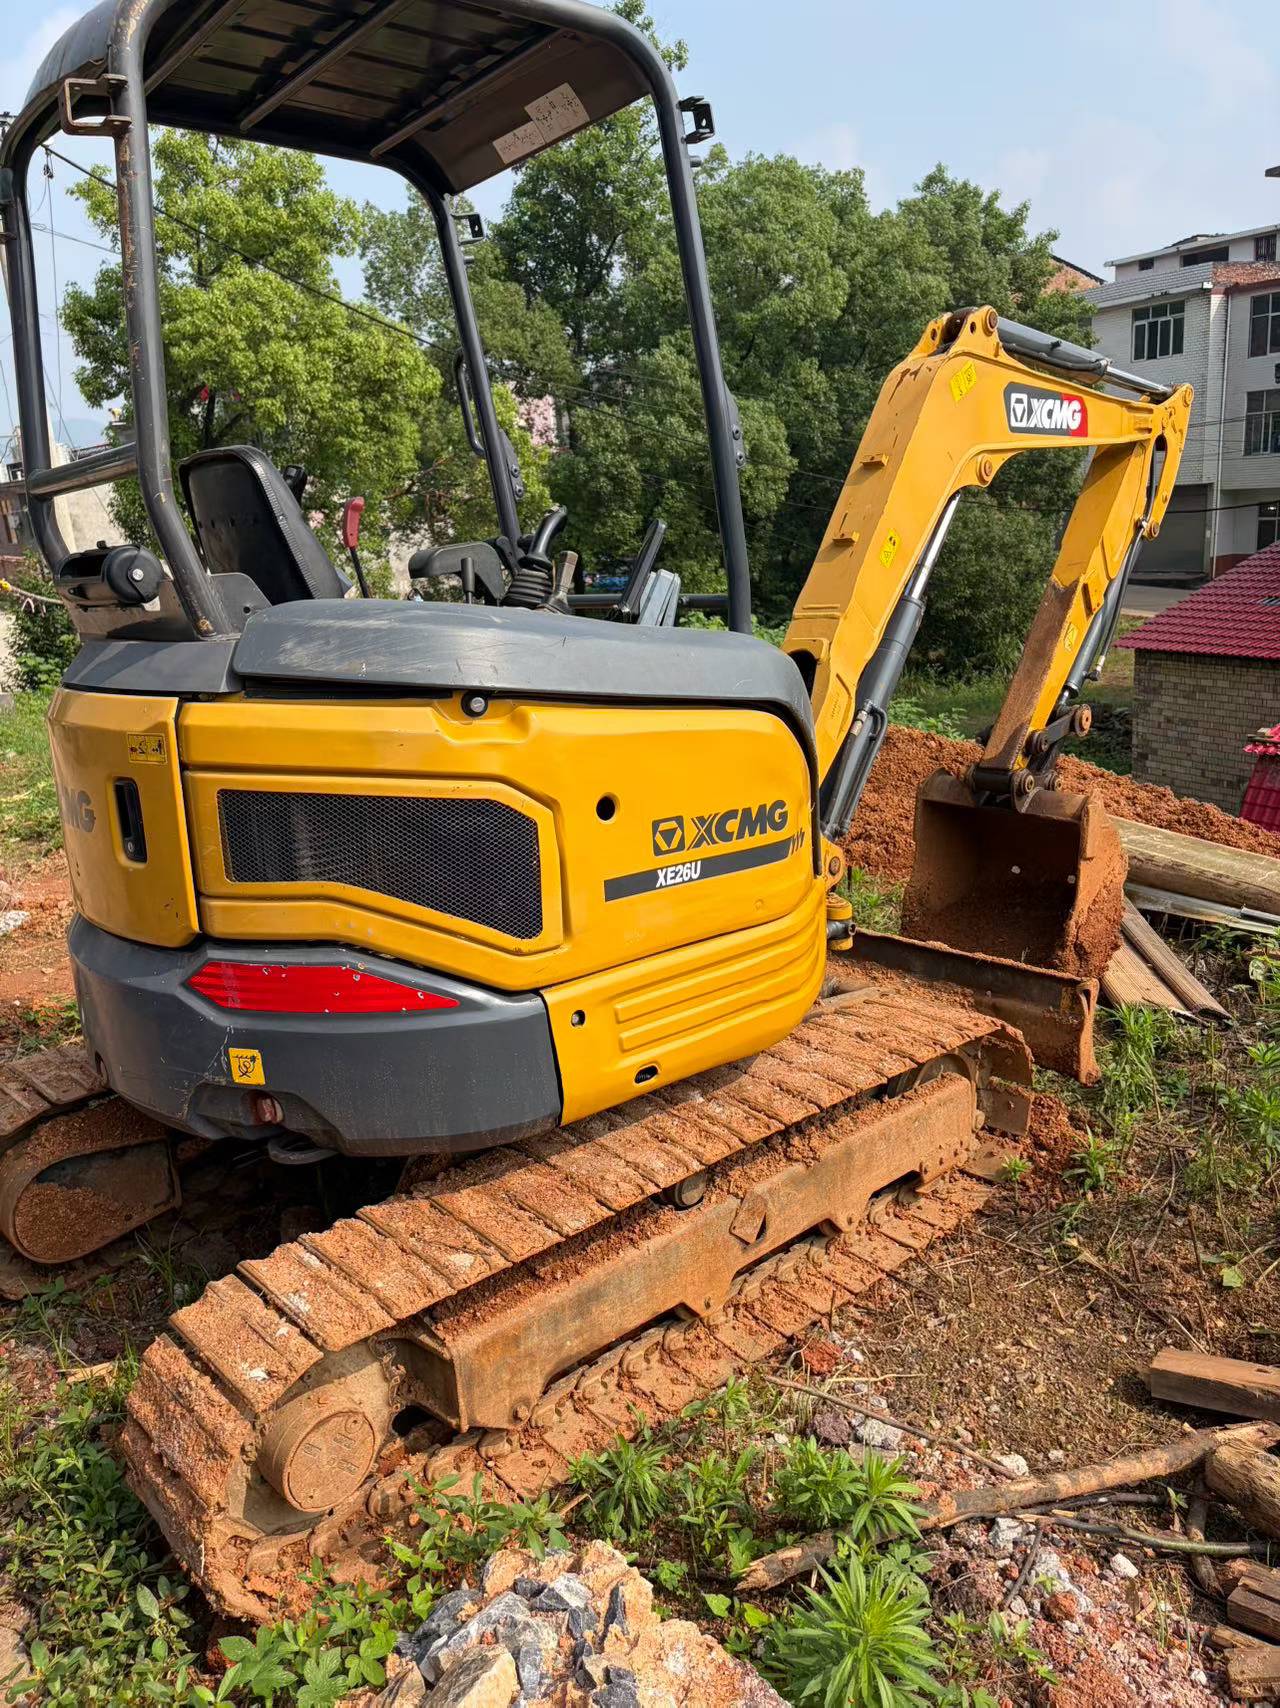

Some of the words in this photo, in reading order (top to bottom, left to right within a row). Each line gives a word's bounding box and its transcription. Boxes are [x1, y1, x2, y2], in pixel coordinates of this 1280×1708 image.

[1026, 398, 1082, 430] XCMG
[686, 799, 789, 850] XCMG
[655, 860, 702, 888] XE26U
